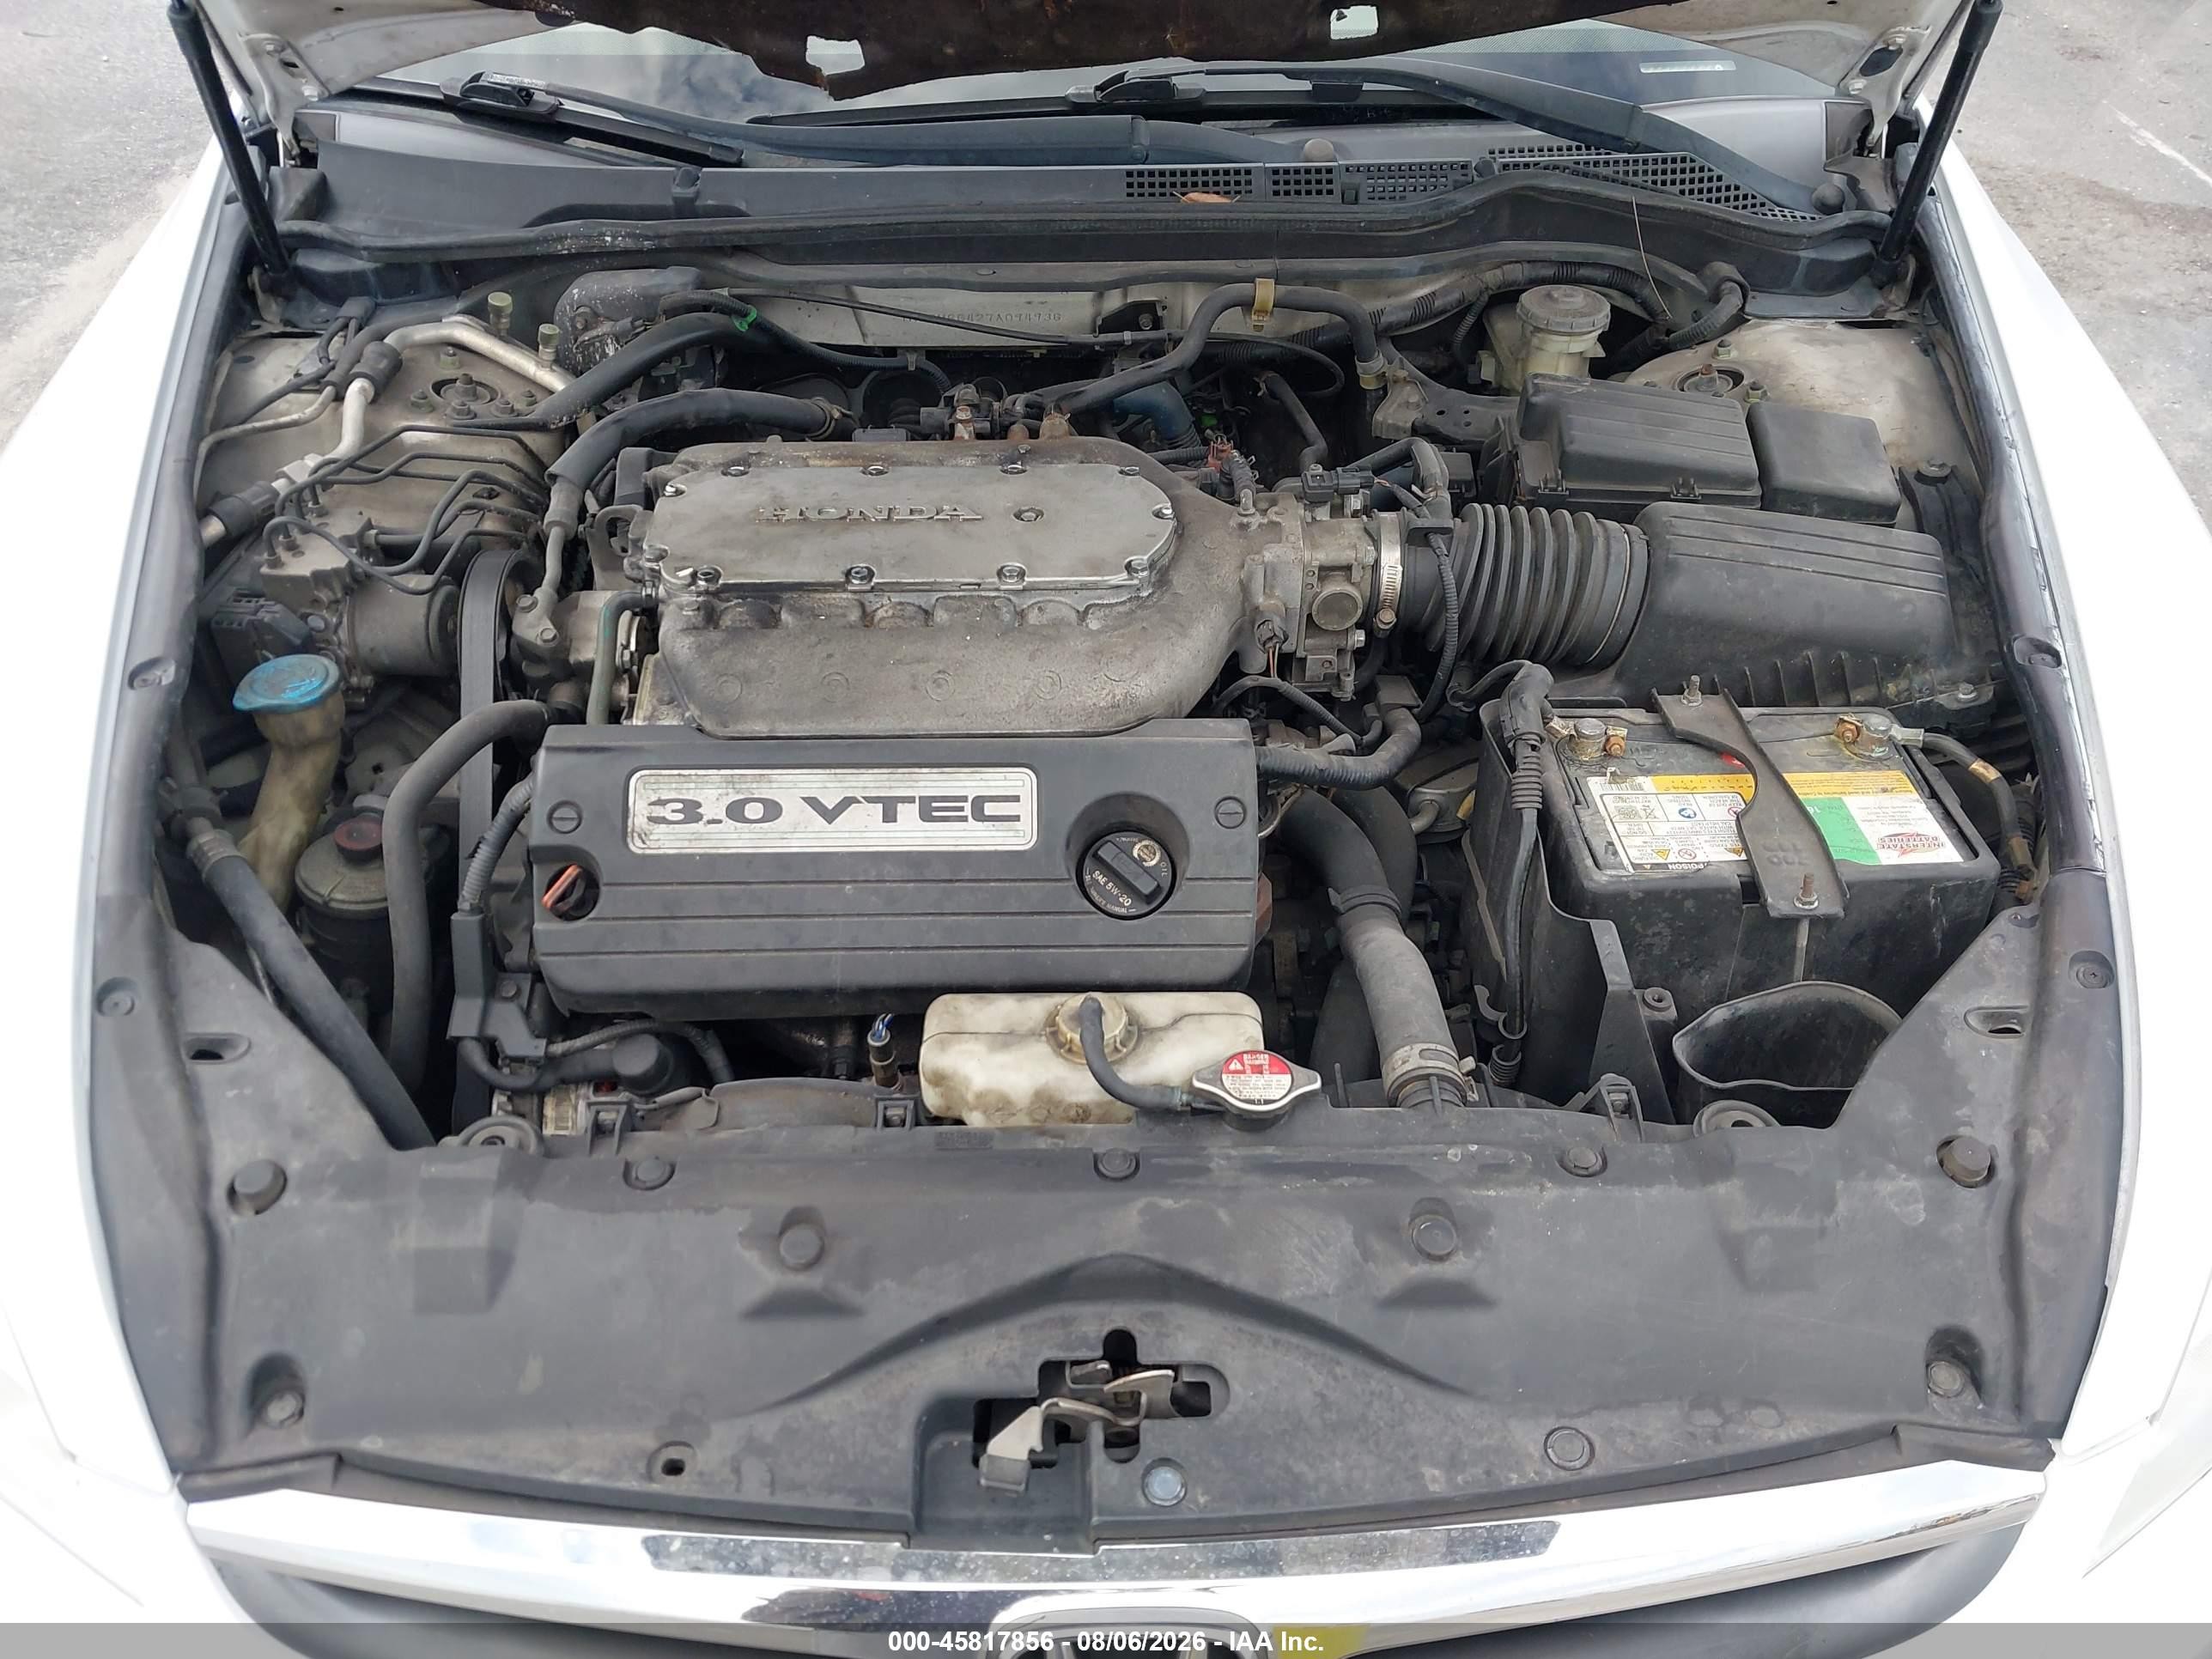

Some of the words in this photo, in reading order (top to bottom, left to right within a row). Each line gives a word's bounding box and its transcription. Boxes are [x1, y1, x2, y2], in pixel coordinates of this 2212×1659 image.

[755, 505, 984, 522] HONDA
[646, 796, 784, 825] 3.0
[799, 794, 1021, 825] VTEC
[1668, 862, 1705, 871] POISON
[1092, 870, 1108, 886] SAE
[1105, 882, 1132, 906] 5W-20
